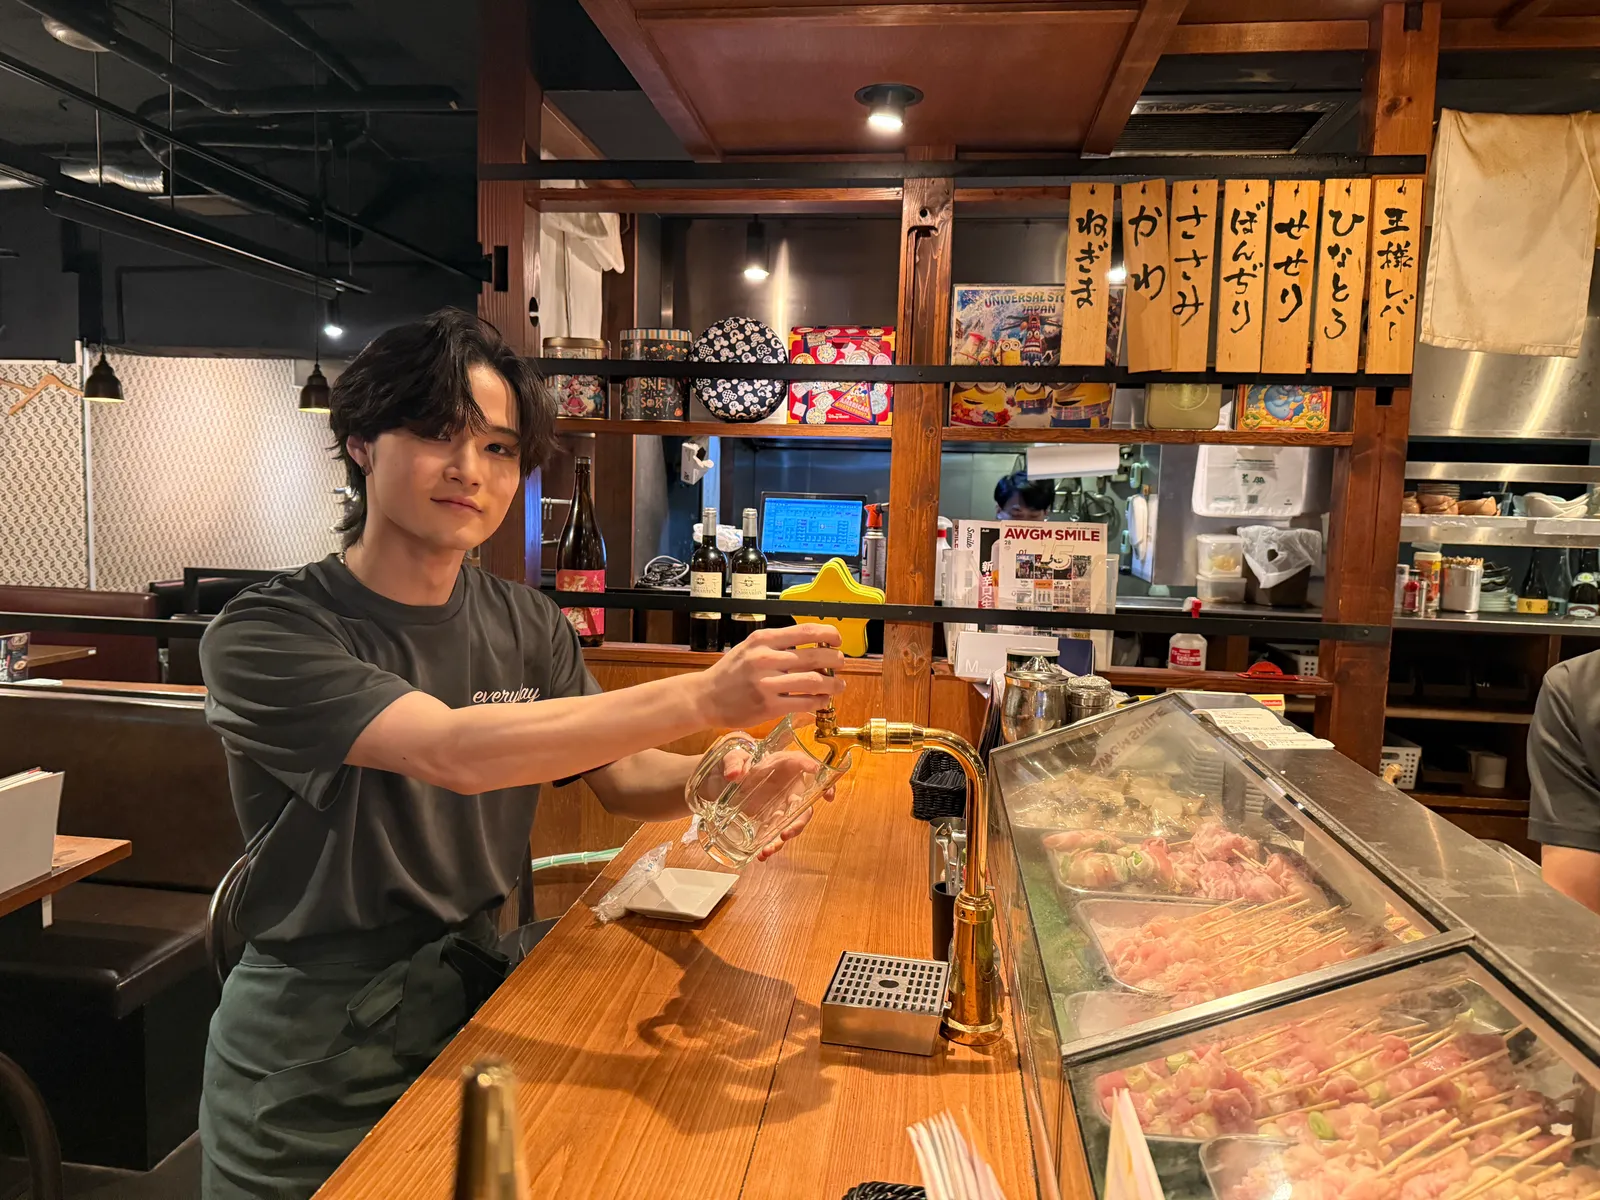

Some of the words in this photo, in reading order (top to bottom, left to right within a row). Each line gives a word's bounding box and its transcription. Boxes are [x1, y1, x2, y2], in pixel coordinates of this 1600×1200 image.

[985, 291, 1046, 308] UNIVERSAL
[1070, 208, 1108, 308] ねぎま
[1128, 204, 1167, 301] かわ
[1171, 205, 1209, 326] ささみ
[1223, 200, 1266, 334] ぼんぢり
[1273, 209, 1310, 323] せせり
[1323, 208, 1365, 340] ひなとろ
[1377, 207, 1415, 341] 王様レバー
[1021, 303, 1056, 315] JAPAN
[966, 527, 975, 549] Smile
[1004, 528, 1052, 540] AWGM
[1055, 529, 1100, 541] SMILE
